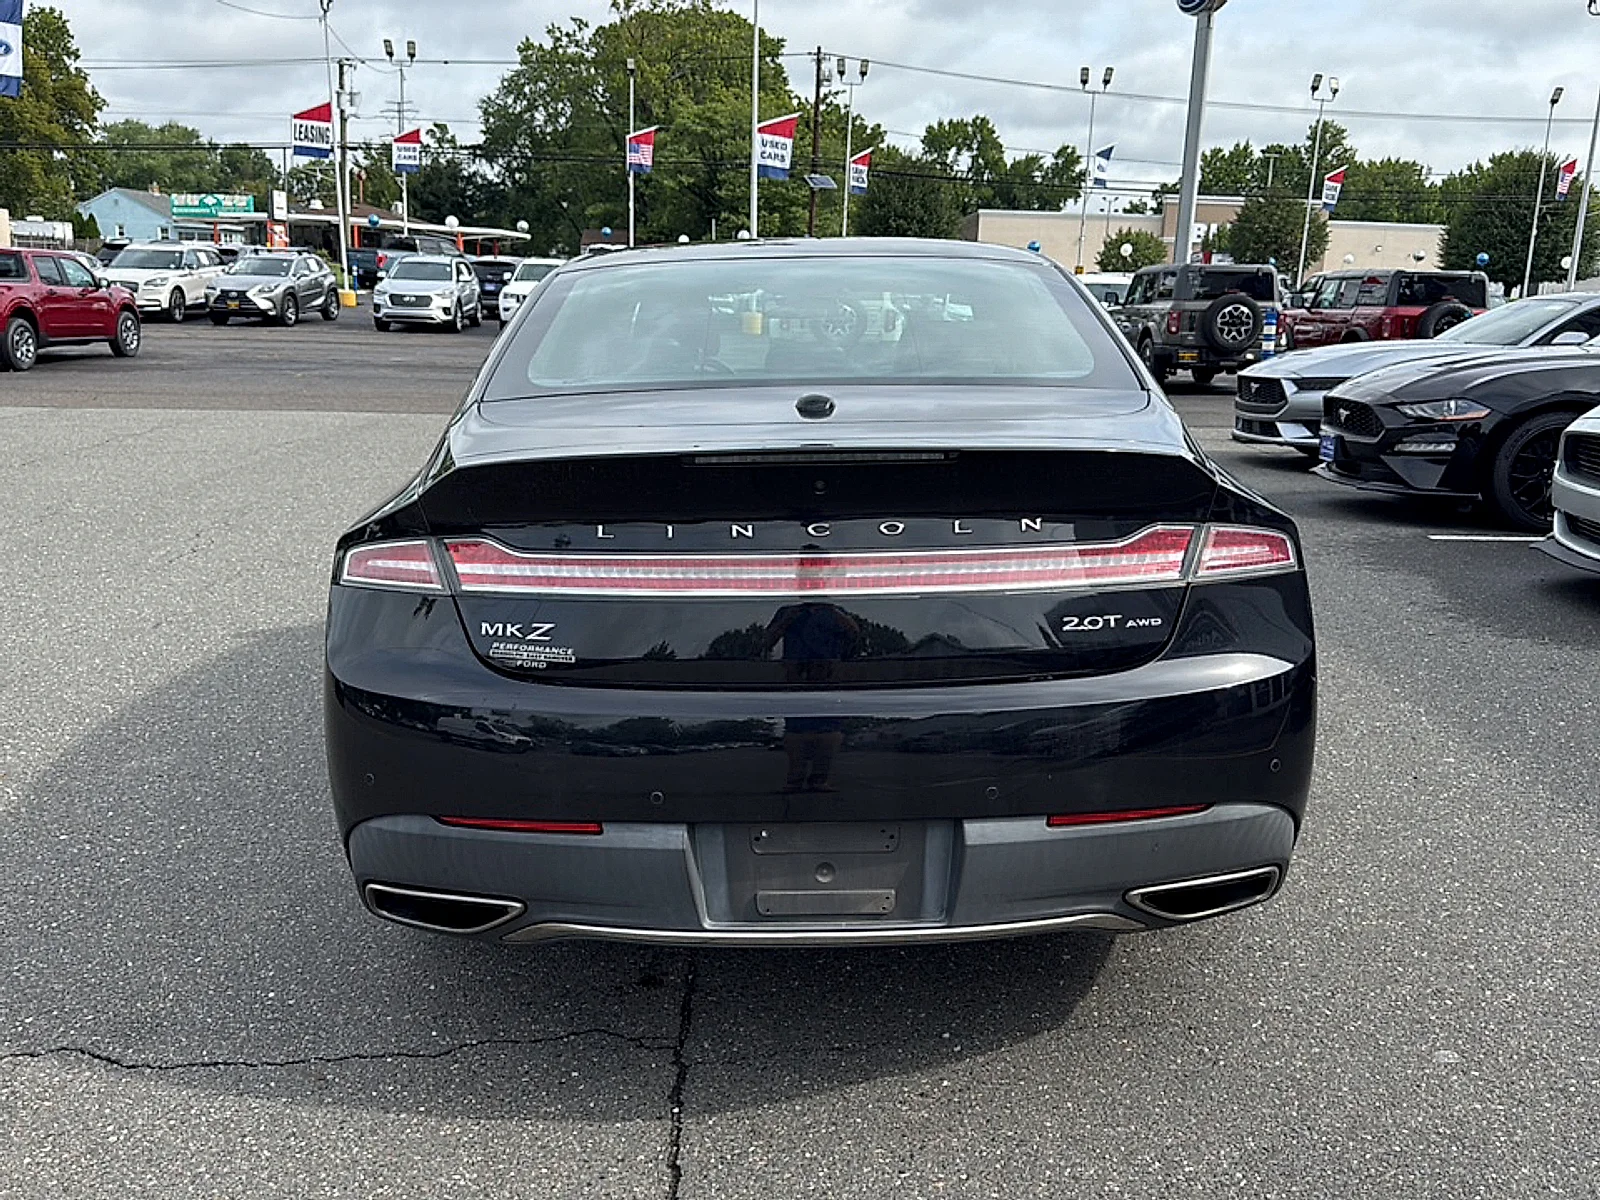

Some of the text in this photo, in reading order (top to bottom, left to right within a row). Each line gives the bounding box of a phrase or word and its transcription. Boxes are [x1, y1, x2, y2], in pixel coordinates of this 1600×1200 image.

[293, 123, 330, 144] LEASING
[761, 138, 788, 151] USED
[760, 151, 786, 163] CARS
[597, 517, 1044, 539] LINCOLN
[1125, 618, 1162, 628] AWD
[481, 621, 556, 641] MKZ
[491, 641, 574, 655] PERFORMANCE
[516, 659, 547, 669] FORD
